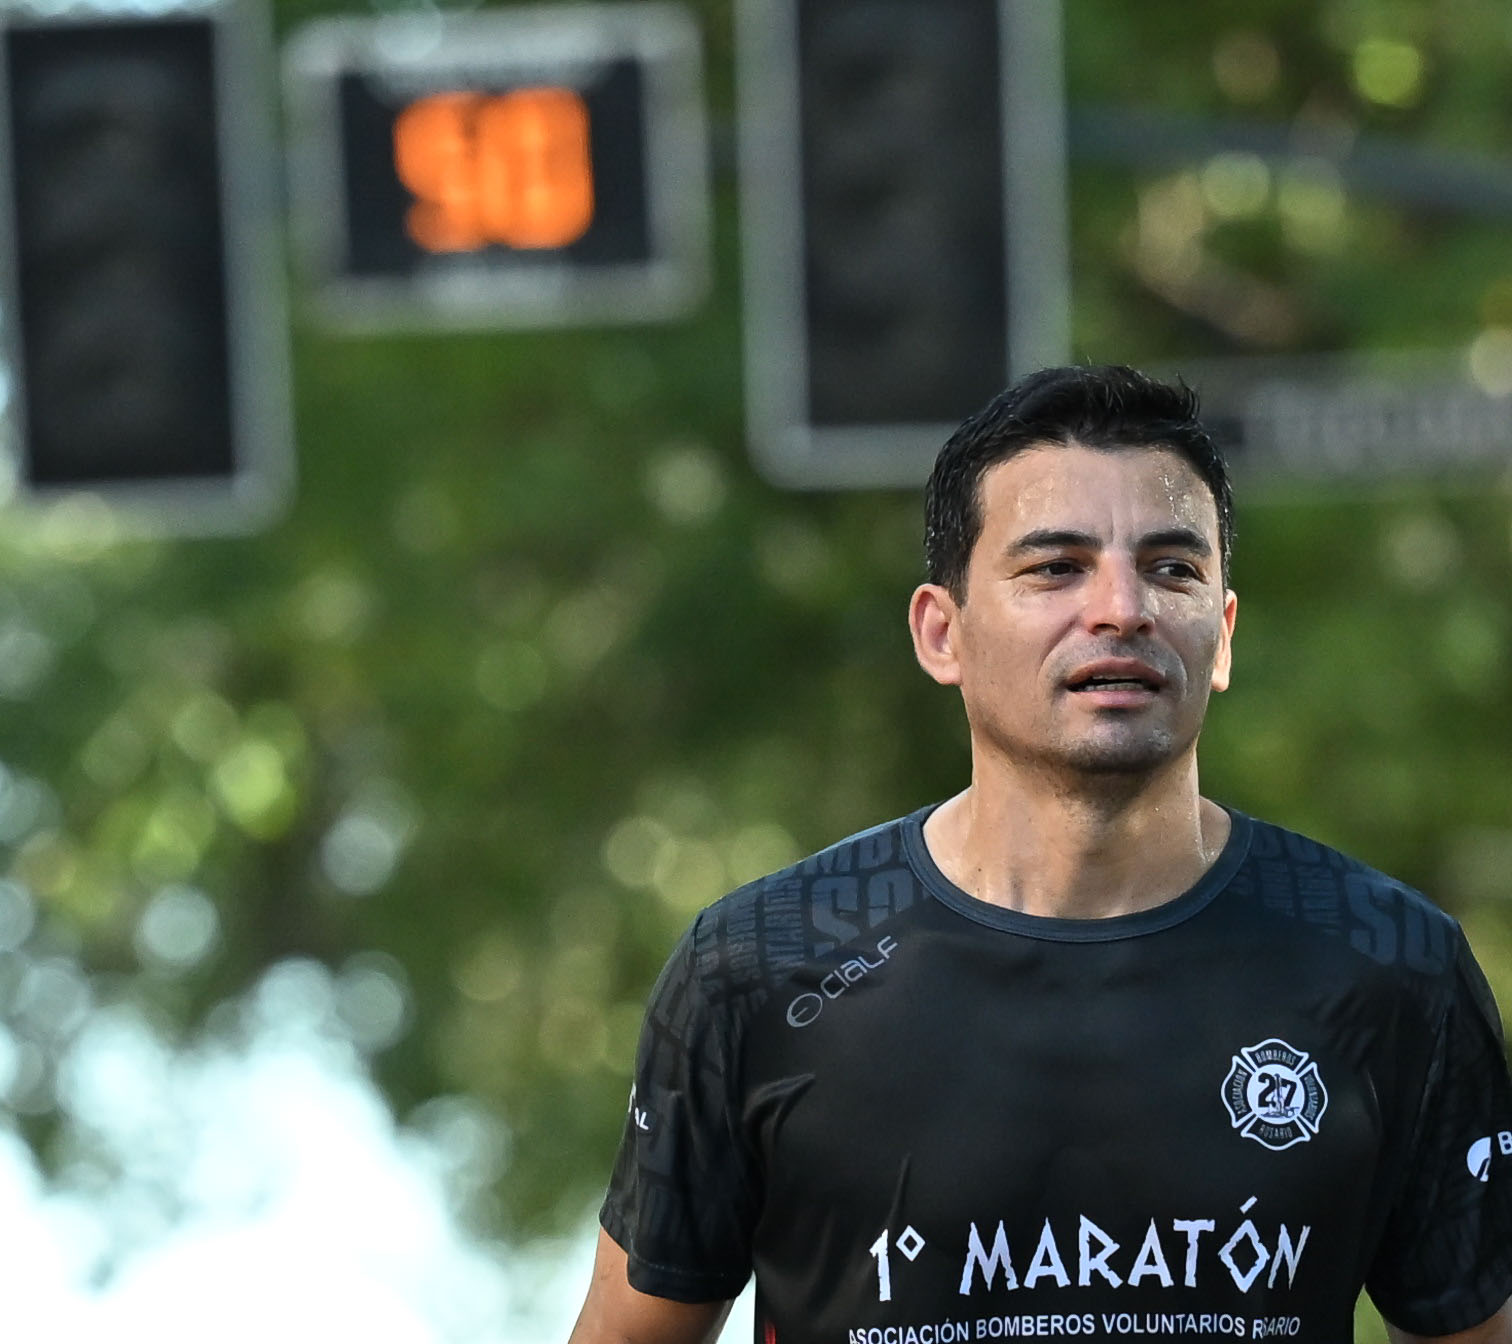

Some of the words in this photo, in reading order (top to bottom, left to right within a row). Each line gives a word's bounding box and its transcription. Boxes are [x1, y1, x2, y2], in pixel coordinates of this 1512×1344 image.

[1258, 1072, 1298, 1108] 27
[959, 1196, 1311, 1296] MARATÓN
[976, 1313, 1095, 1340] BOMBEROS
[1102, 1313, 1246, 1337] VOLUNTARIOS
[1252, 1316, 1301, 1340] RARIO
